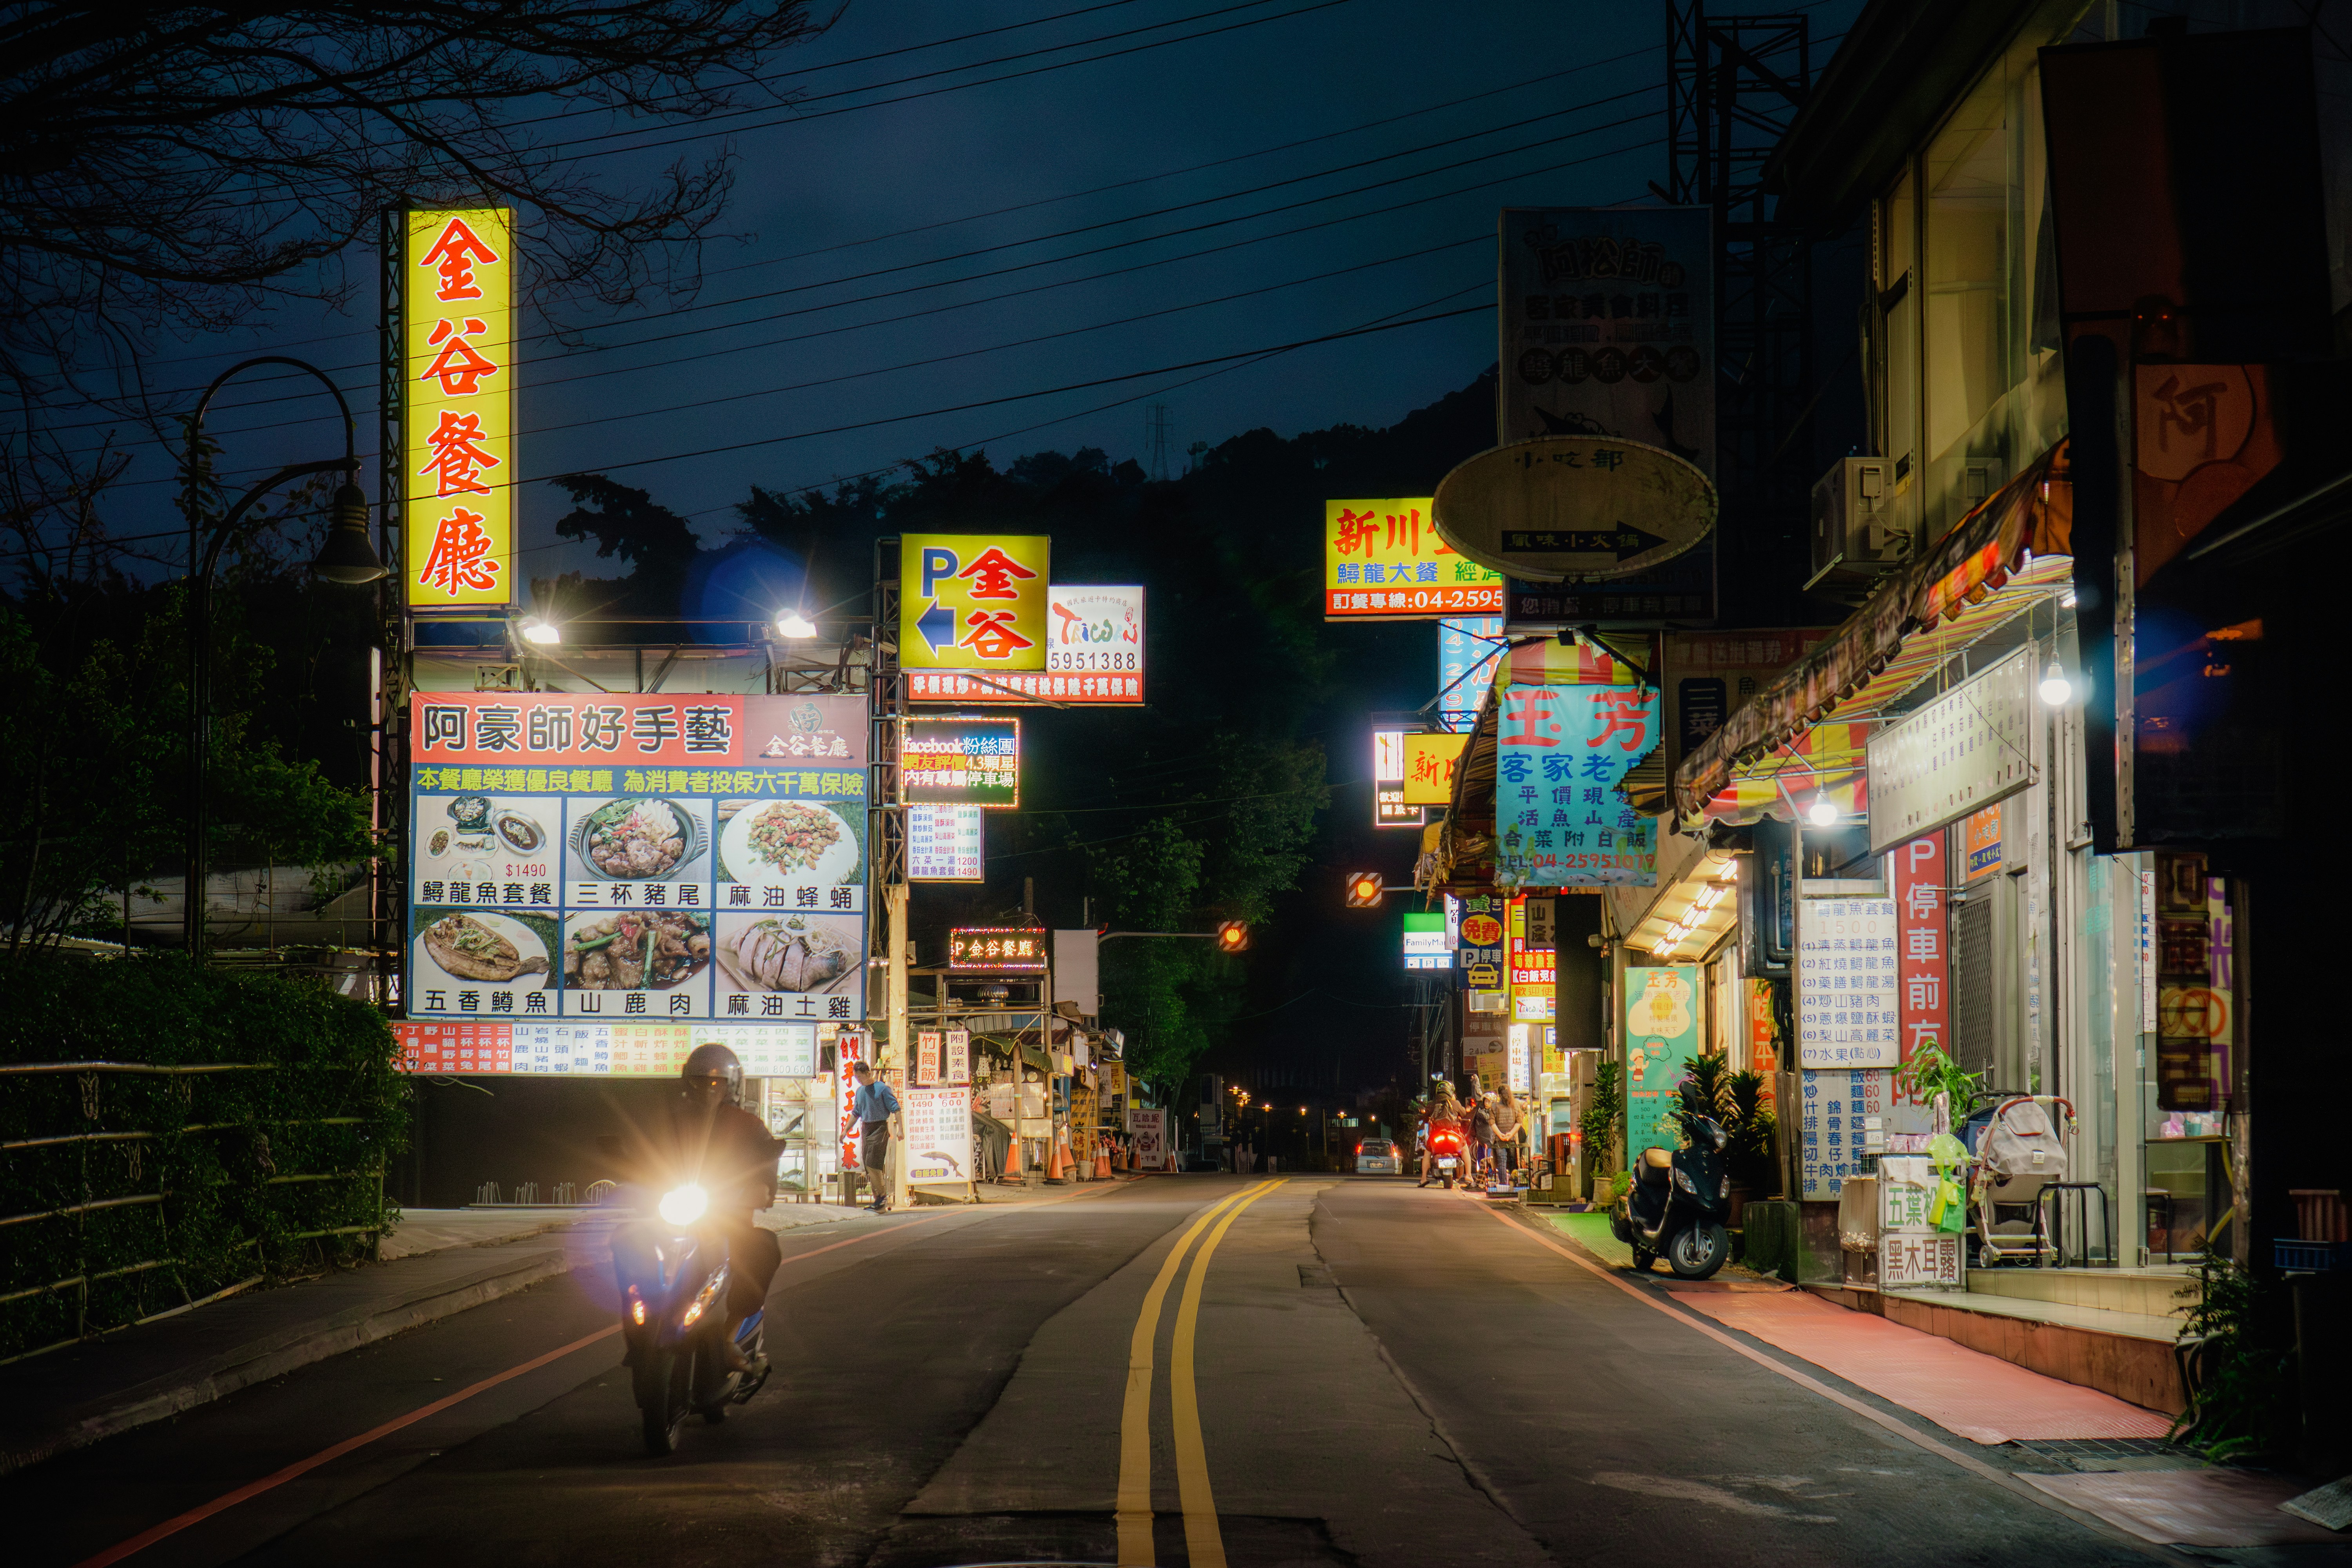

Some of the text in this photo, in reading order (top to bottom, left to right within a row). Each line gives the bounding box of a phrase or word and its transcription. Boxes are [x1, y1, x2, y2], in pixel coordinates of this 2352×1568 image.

[419, 218, 501, 597] 金谷餐廳
[1515, 449, 1624, 472] 小吃部
[1509, 534, 1639, 548] 風味小火鍋
[921, 547, 959, 598] P
[1338, 562, 1437, 584] 鱘龍大餐
[957, 546, 1038, 660] 金谷
[1067, 595, 1127, 606] 國民旅遊卡特約商店
[1051, 652, 1135, 670] 5951388
[423, 704, 733, 755] 阿豪師好手藝
[1500, 688, 1659, 752] 玉芳
[766, 735, 849, 757] 金谷餐廳
[1500, 751, 1645, 782] 客家老
[417, 769, 864, 796] 本餐廳榮獲優良餐廳 為消費者投保六千萬保險
[1519, 809, 1635, 828] 活魚山產
[505, 863, 546, 877] $1490
[912, 856, 955, 865] 六菜一湯
[912, 866, 955, 875] 鱘龍魚套餐
[423, 881, 552, 905] 鱘龍魚套餐
[577, 883, 700, 906] 三杯豬尾
[729, 886, 853, 909] 麻油蜂蛹
[1818, 902, 1895, 917] 鱘龍魚套餐
[1463, 918, 1500, 942] 免費
[1820, 920, 1877, 934] 1500
[955, 940, 1033, 957] P 金谷餐廳
[1406, 938, 1445, 947] FamilyMa
[1802, 938, 1896, 952] (1) 清蒸鱘龍魚
[1466, 952, 1474, 964] P
[1481, 949, 1501, 963] 停車
[1802, 957, 1895, 971] (2) 紅燒鱘龍魚
[1646, 971, 1680, 989] 玉芳
[1802, 976, 1895, 989] (3) 藥膳鱘龍湯
[425, 991, 547, 1014] 五香鱒魚
[580, 993, 691, 1014] 山鹿肉
[1634, 991, 1691, 1000] 活魚客家老店
[1802, 994, 1880, 1008] (4) 炒山豬肉
[728, 995, 851, 1019] 麻油土雞
[1649, 1014, 1678, 1023] 特製湯頭
[1802, 1014, 1817, 1024] (5)
[1650, 1027, 1678, 1035] 美味天下
[1803, 1028, 1896, 1042] (6) 梨山高麗菜
[442, 1026, 456, 1071] 山貓野菜
[478, 1026, 492, 1071] 三杯豬尾
[496, 1026, 510, 1071] 三杯竹雞
[515, 1027, 528, 1071] 山鹿肉
[534, 1027, 548, 1072] 岩燒山豬肉
[554, 1027, 568, 1072] 石頭蝦
[594, 1027, 608, 1072] 五香鱒魚
[614, 1027, 628, 1072] 蜜汁鯽魚
[634, 1027, 648, 1073] 白斬土雞
[654, 1027, 668, 1073] 酥炸蜂蛹
[755, 1028, 769, 1062] 五菜一湯
[775, 1028, 789, 1062] 四菜一湯
[795, 1028, 809, 1062] 三菜一湯
[840, 1037, 860, 1060] 自製
[1803, 1049, 1817, 1059] (7)
[921, 1035, 937, 1082] 竹筒飯
[950, 1034, 965, 1080] 附設素食
[754, 1065, 769, 1074] 1000
[773, 1065, 790, 1074] 800
[793, 1065, 811, 1074] 600
[1866, 1069, 1880, 1082] 60
[1865, 1085, 1880, 1098] 60
[942, 1099, 962, 1107] 600
[1804, 1100, 1880, 1114] 什錦麵 60
[1803, 1116, 1865, 1131] 排骨麵
[1803, 1131, 1865, 1146] 陽春麵
[915, 1169, 944, 1178] 白飯免費
[1888, 1239, 1956, 1280] 黑木耳露
